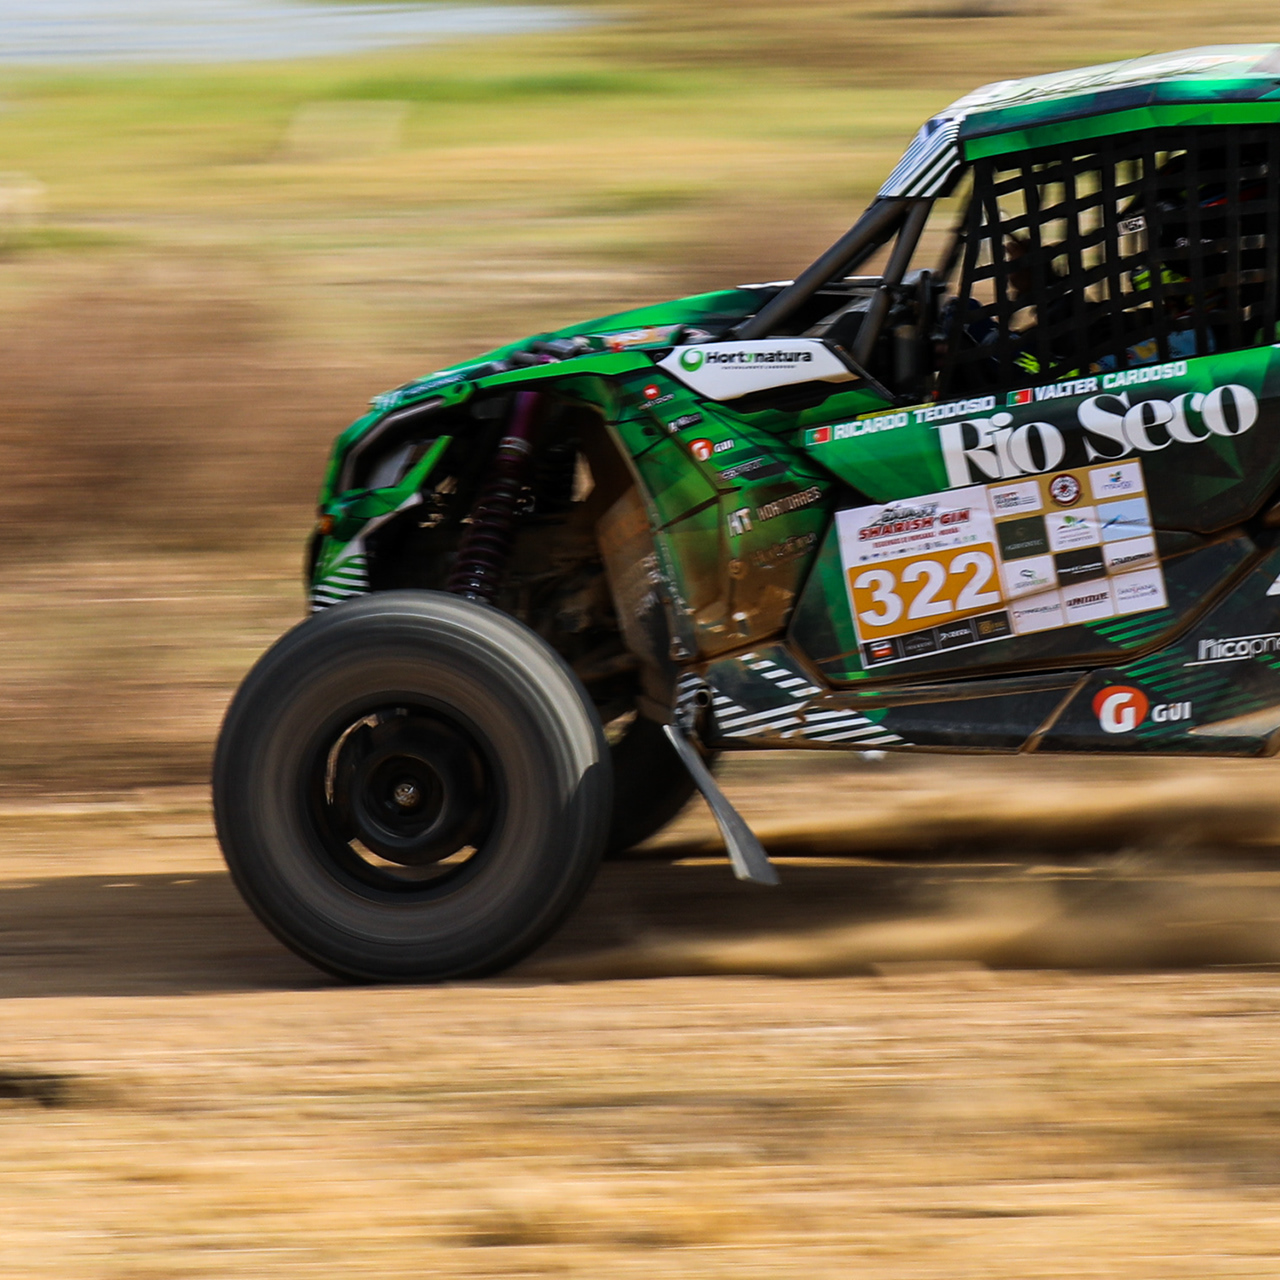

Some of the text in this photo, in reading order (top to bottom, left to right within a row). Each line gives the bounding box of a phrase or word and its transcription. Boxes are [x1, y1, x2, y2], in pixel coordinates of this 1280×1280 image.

[833, 411, 909, 440] RICARDO
[1034, 377, 1099, 402] VALTER
[1102, 361, 1188, 389] CARDOSO
[931, 383, 1259, 489] Rio Seco
[854, 550, 1000, 628] 322
[1151, 701, 1193, 723] GUI
